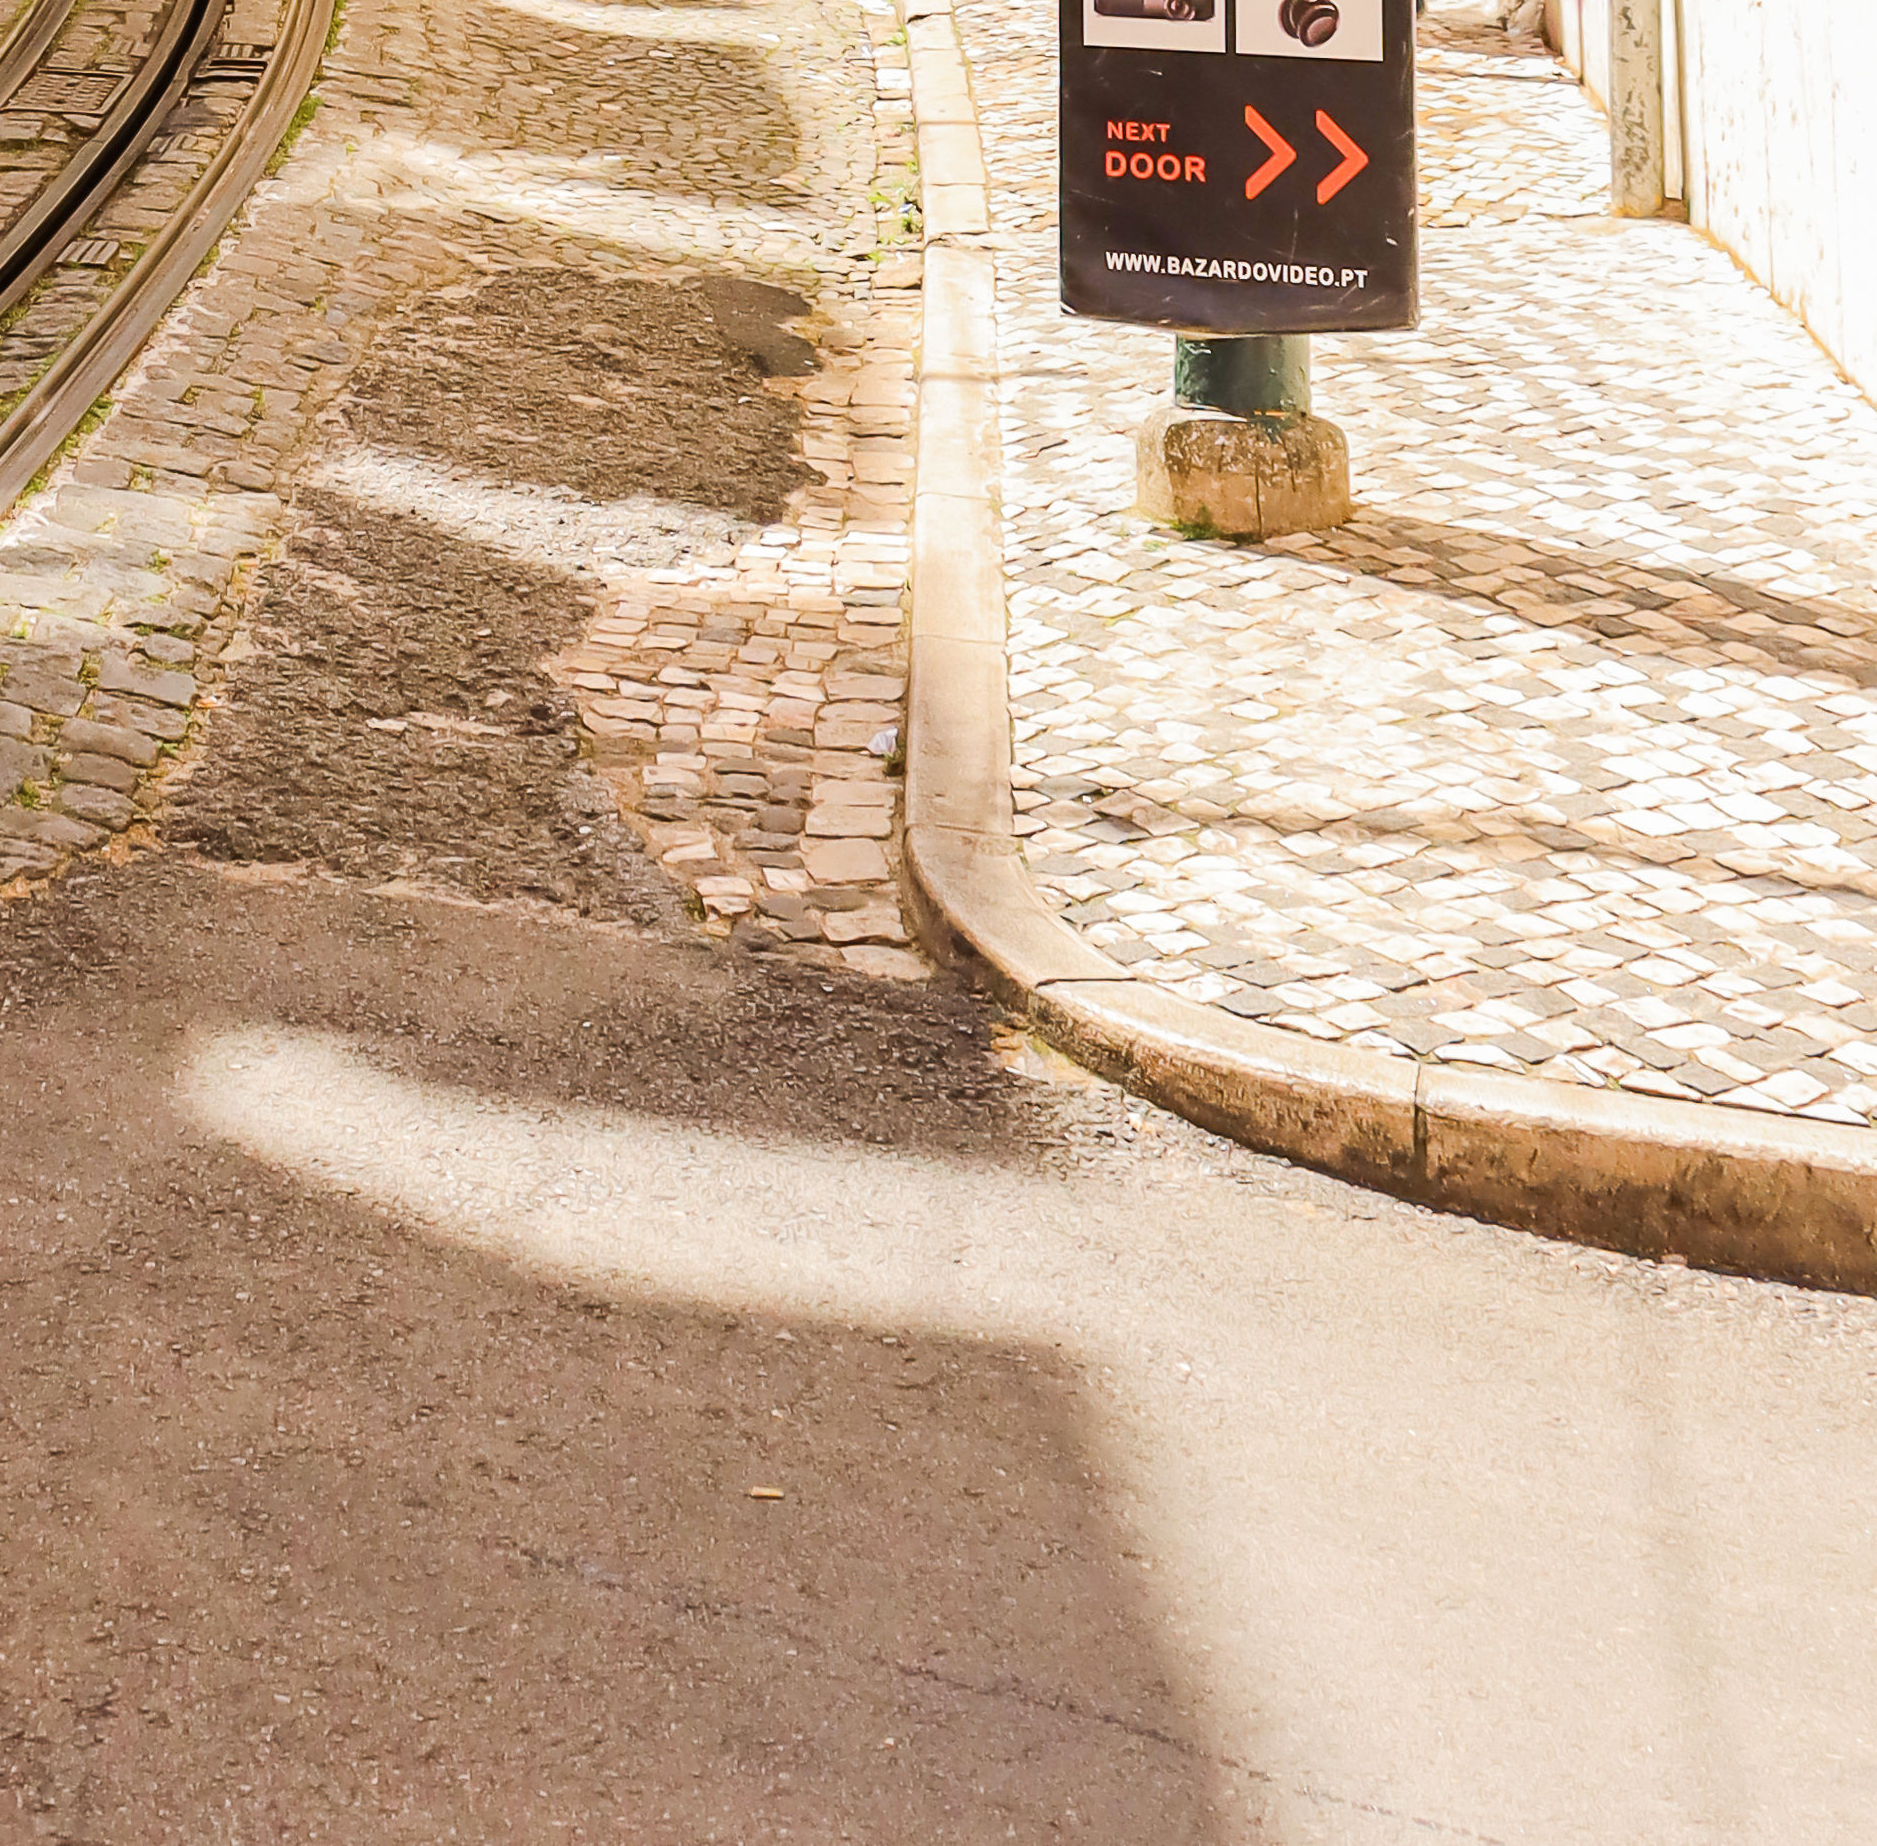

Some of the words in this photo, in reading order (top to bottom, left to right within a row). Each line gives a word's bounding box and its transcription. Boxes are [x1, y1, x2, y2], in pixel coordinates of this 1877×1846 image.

[1106, 120, 1171, 143] NEXT
[1105, 150, 1206, 183] DOOR
[1105, 251, 1369, 289] WWW.BAZARDOVIDEO.PT
